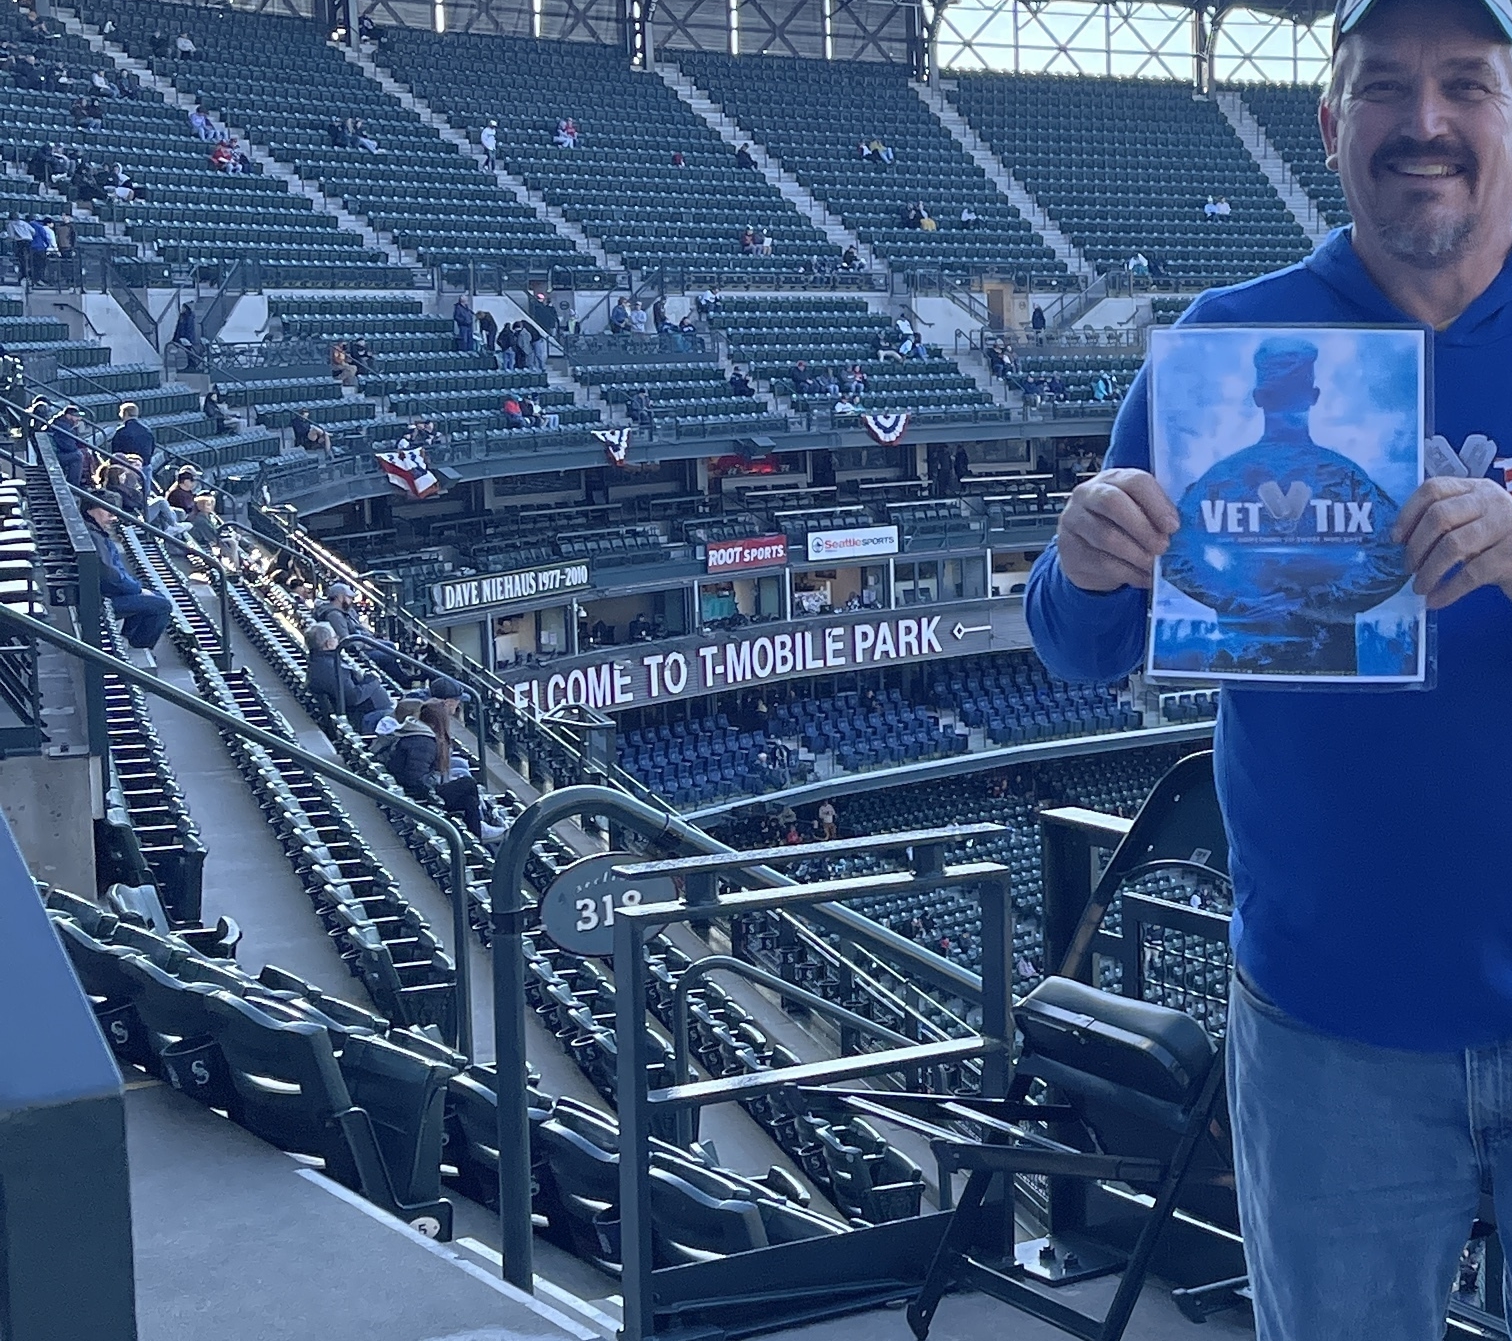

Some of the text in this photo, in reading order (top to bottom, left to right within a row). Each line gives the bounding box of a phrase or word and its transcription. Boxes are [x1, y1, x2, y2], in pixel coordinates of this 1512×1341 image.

[1200, 498, 1373, 533] VET TIX
[708, 544, 784, 567] ROOT SPORTS
[444, 564, 588, 610] DAVE NIEHAUS 1977-2010
[514, 614, 943, 723] ELCOME TO T-MOBILE PARK
[111, 1020, 128, 1044] S
[191, 1060, 210, 1084] S
